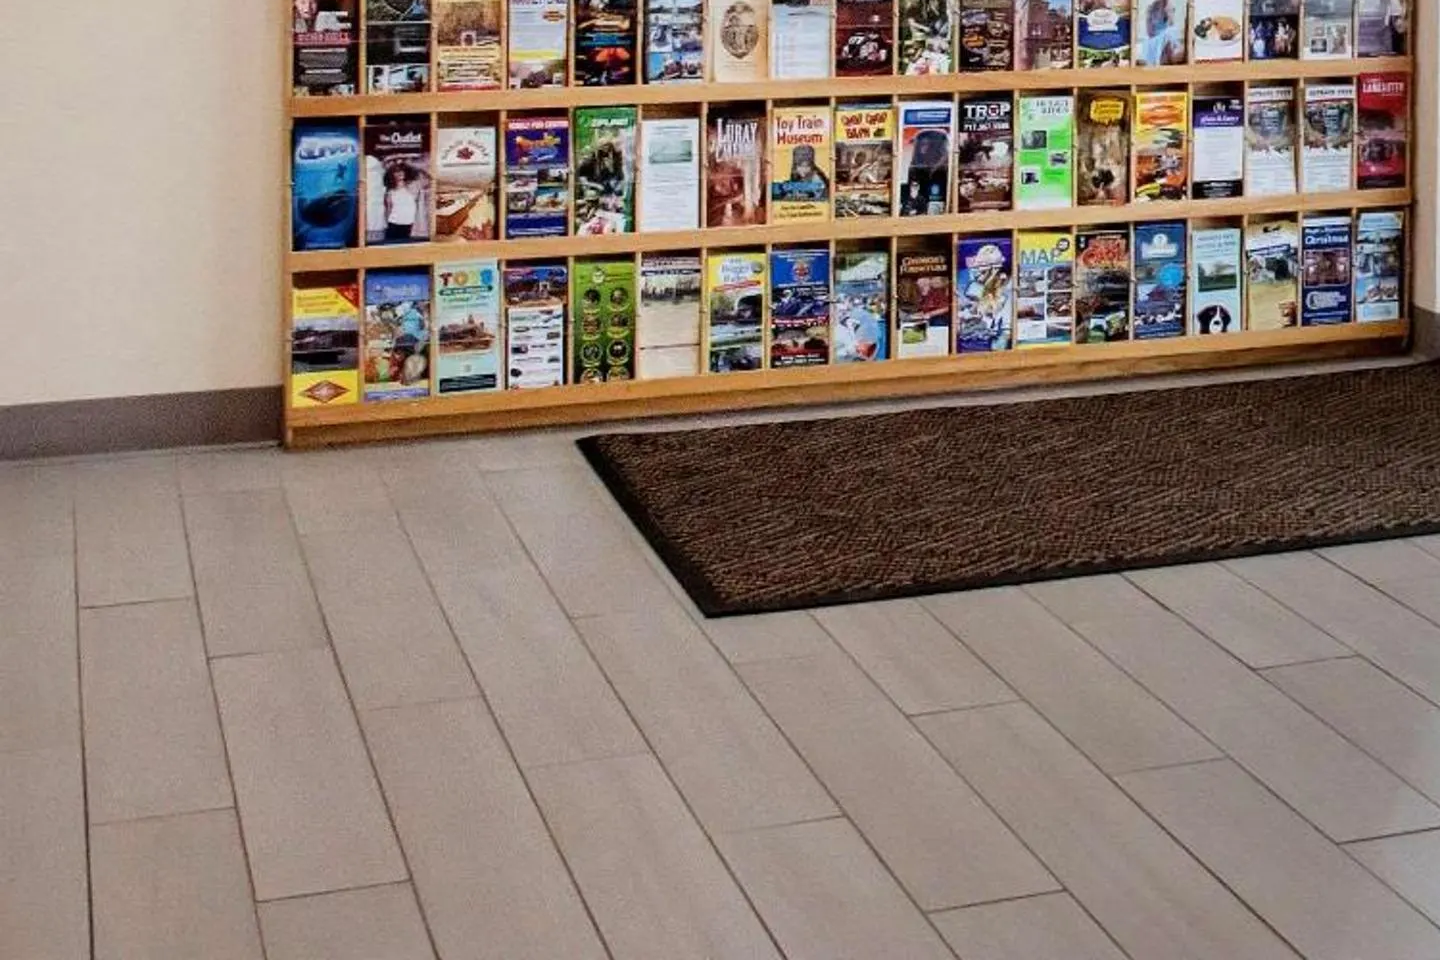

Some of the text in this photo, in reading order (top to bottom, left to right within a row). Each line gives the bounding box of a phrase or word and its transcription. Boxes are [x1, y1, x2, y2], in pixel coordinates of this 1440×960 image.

[776, 115, 824, 131] Toy Train
[717, 118, 758, 145] LURAY
[777, 133, 824, 145] Museum
